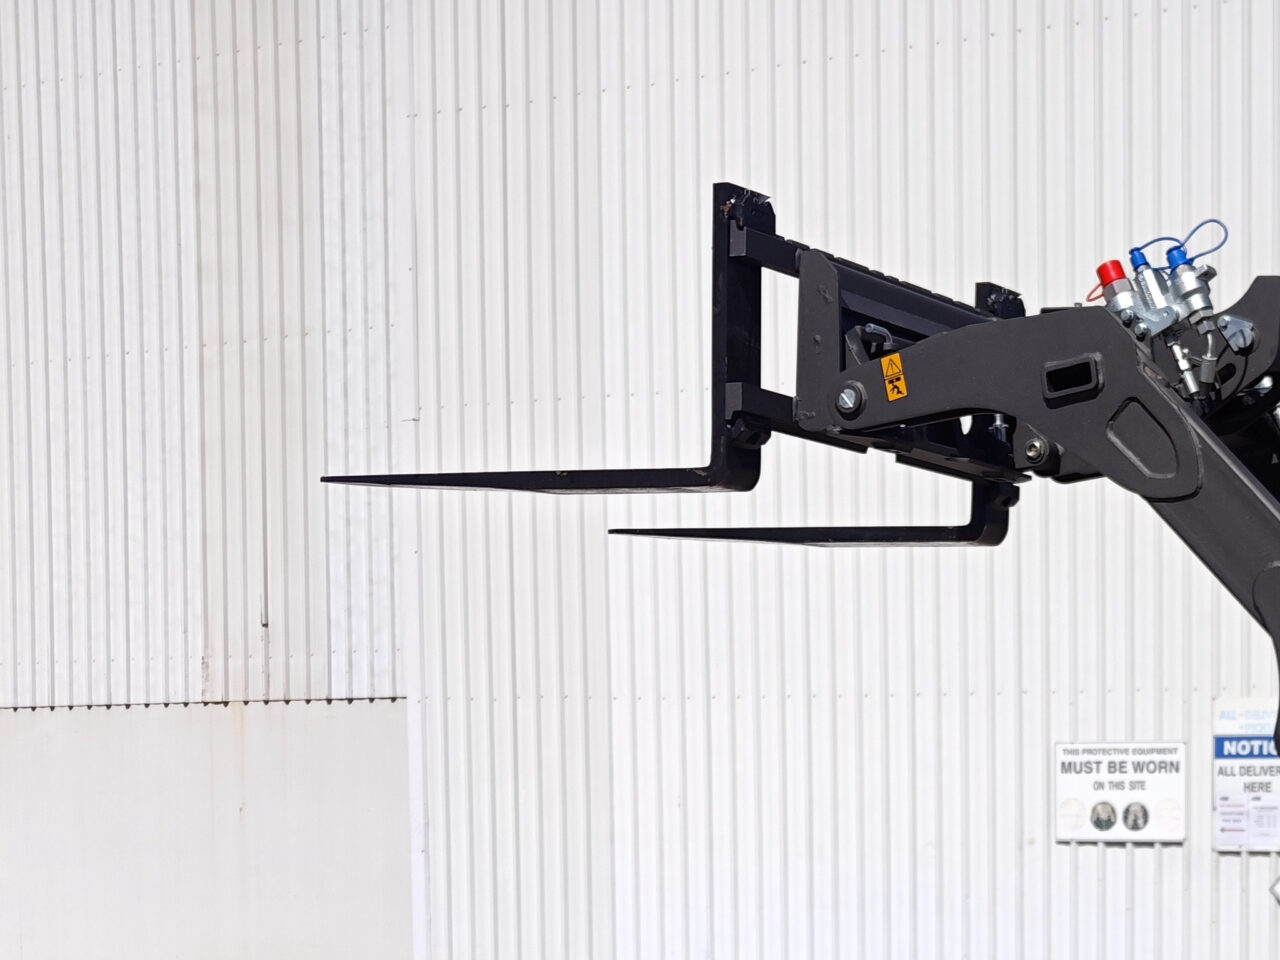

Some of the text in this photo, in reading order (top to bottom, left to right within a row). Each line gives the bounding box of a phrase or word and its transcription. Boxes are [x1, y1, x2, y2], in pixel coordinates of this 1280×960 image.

[1062, 747, 1179, 756] THIS PROTECTIVE EQUIPMENT
[1223, 740, 1278, 755] NOTI
[1060, 761, 1181, 774] MUST BE WORN
[1217, 766, 1236, 777] ALL
[1093, 781, 1146, 791] ON THIS SITE
[1243, 782, 1273, 793] HERE
